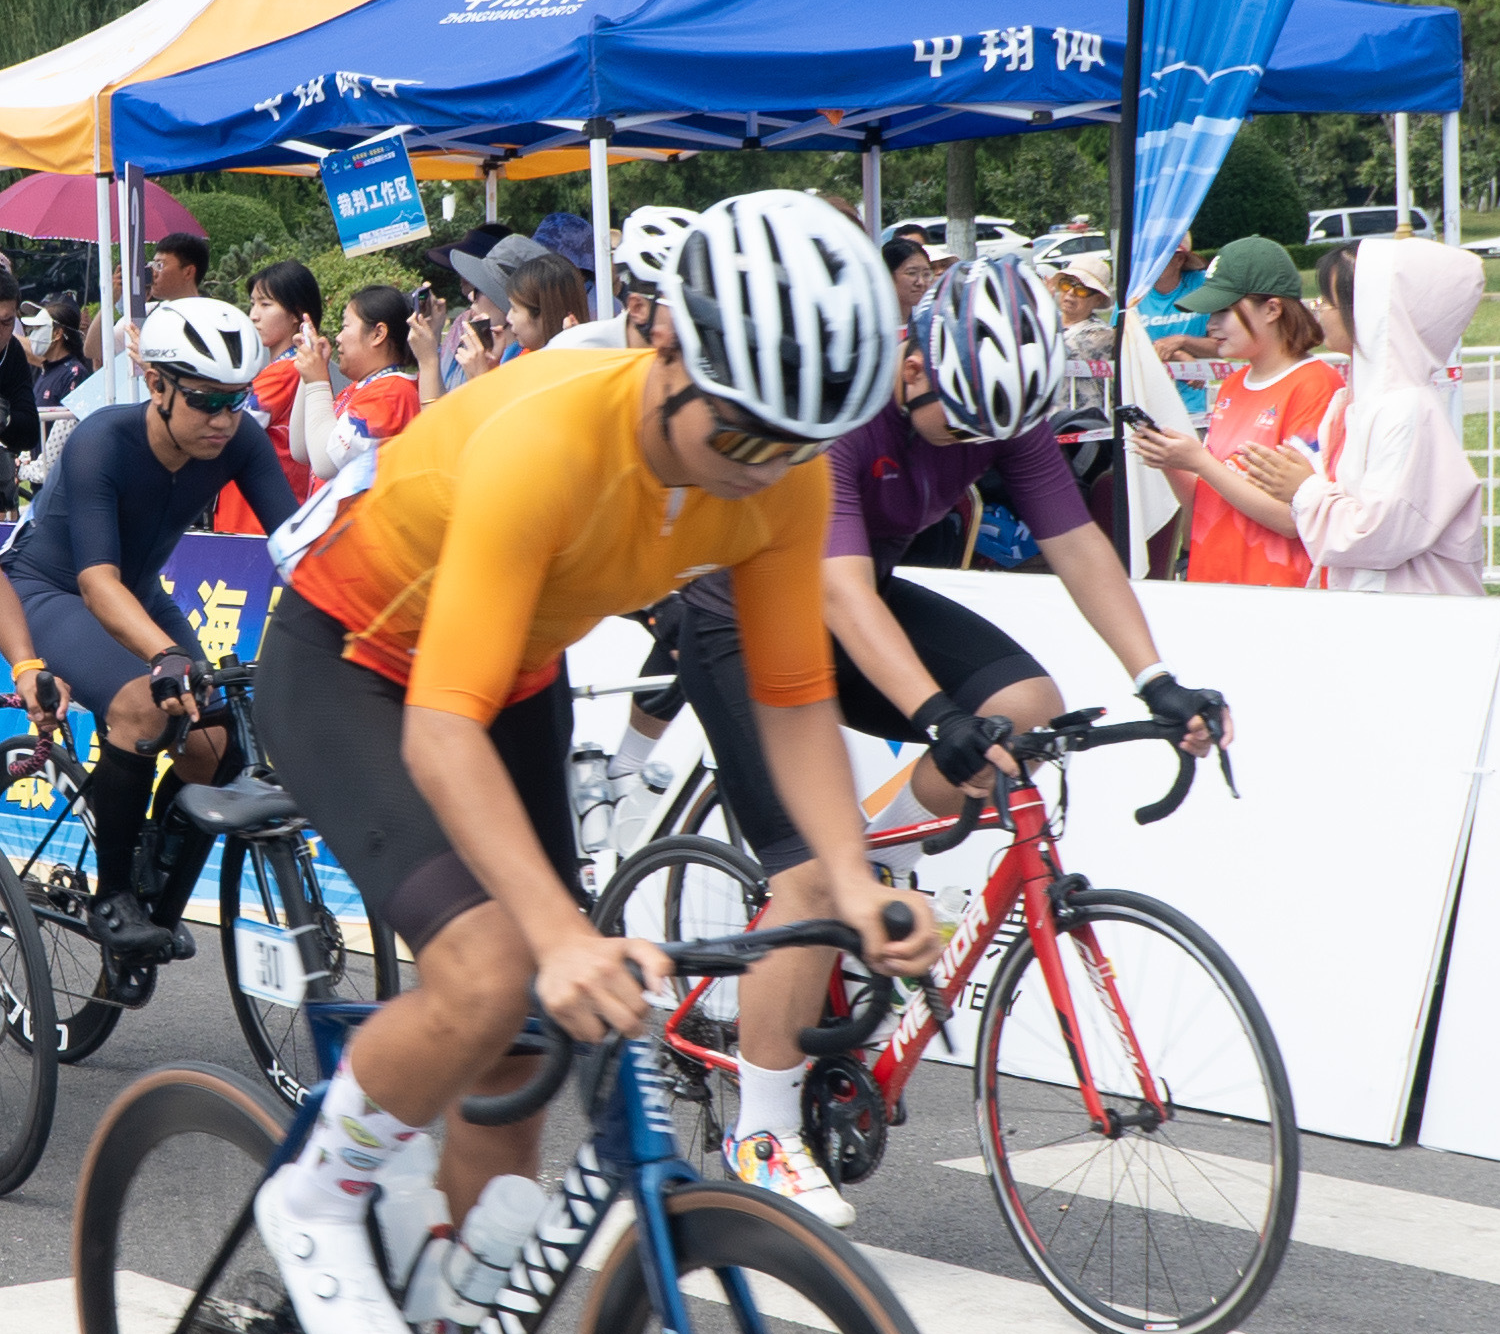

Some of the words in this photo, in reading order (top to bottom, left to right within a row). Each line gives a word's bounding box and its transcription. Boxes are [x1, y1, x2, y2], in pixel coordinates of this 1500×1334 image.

[438, 8, 526, 26] ZHONGXIANG
[527, 4, 583, 19] SPORTS
[336, 175, 414, 219] 裁判工作区
